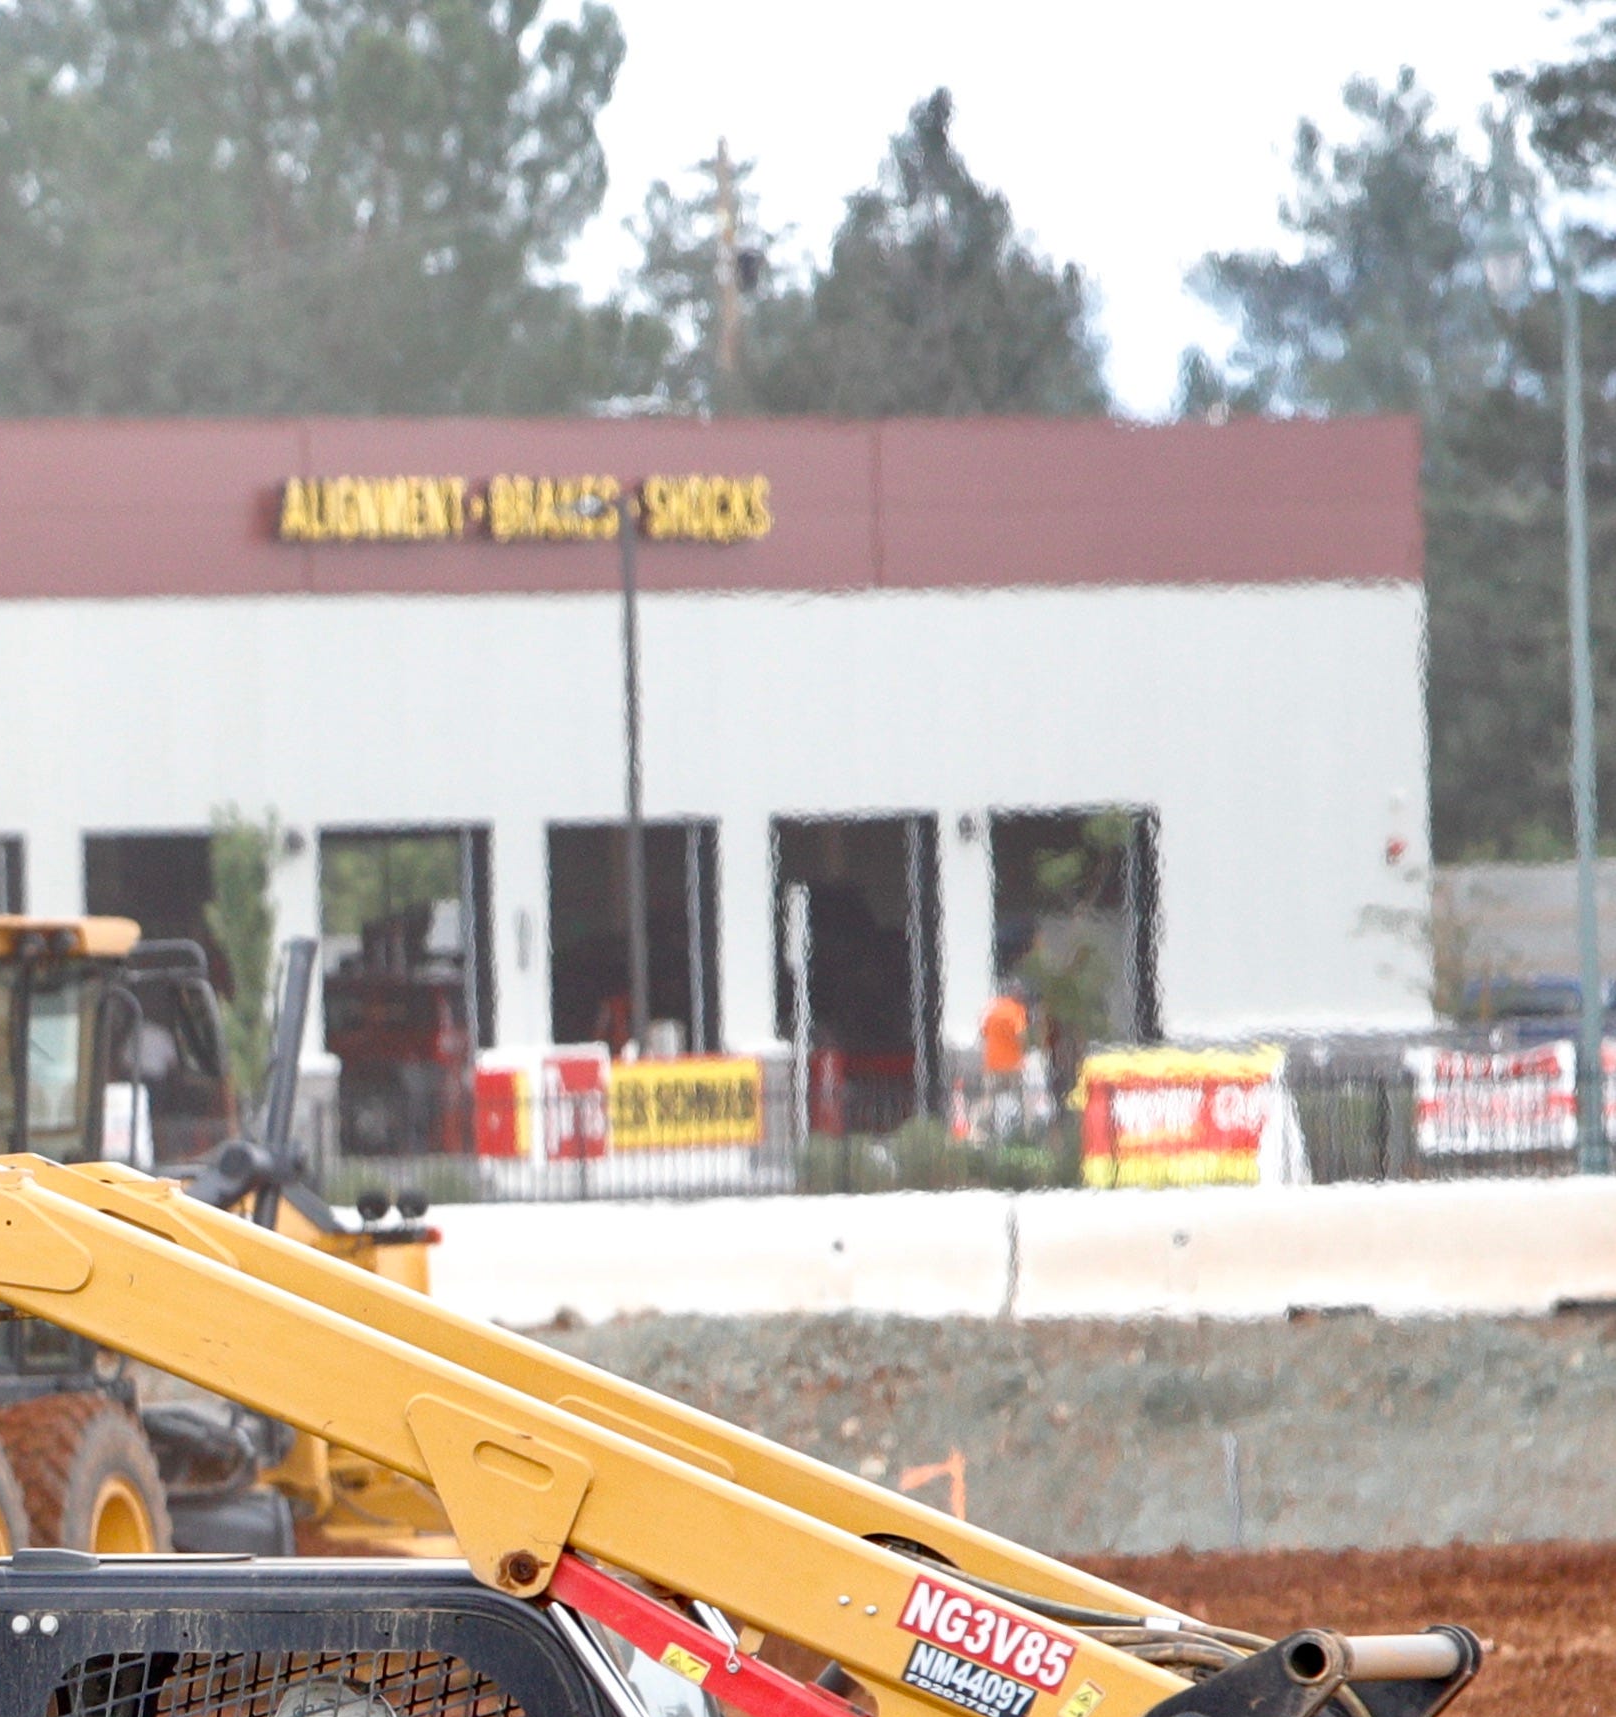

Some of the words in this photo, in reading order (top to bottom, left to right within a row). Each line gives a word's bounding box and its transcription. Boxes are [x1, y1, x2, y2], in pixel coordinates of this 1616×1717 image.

[903, 1582, 1074, 1687] NG3V85
[905, 1673, 1002, 1717] FD203783
[909, 1643, 1036, 1716] NM44097
